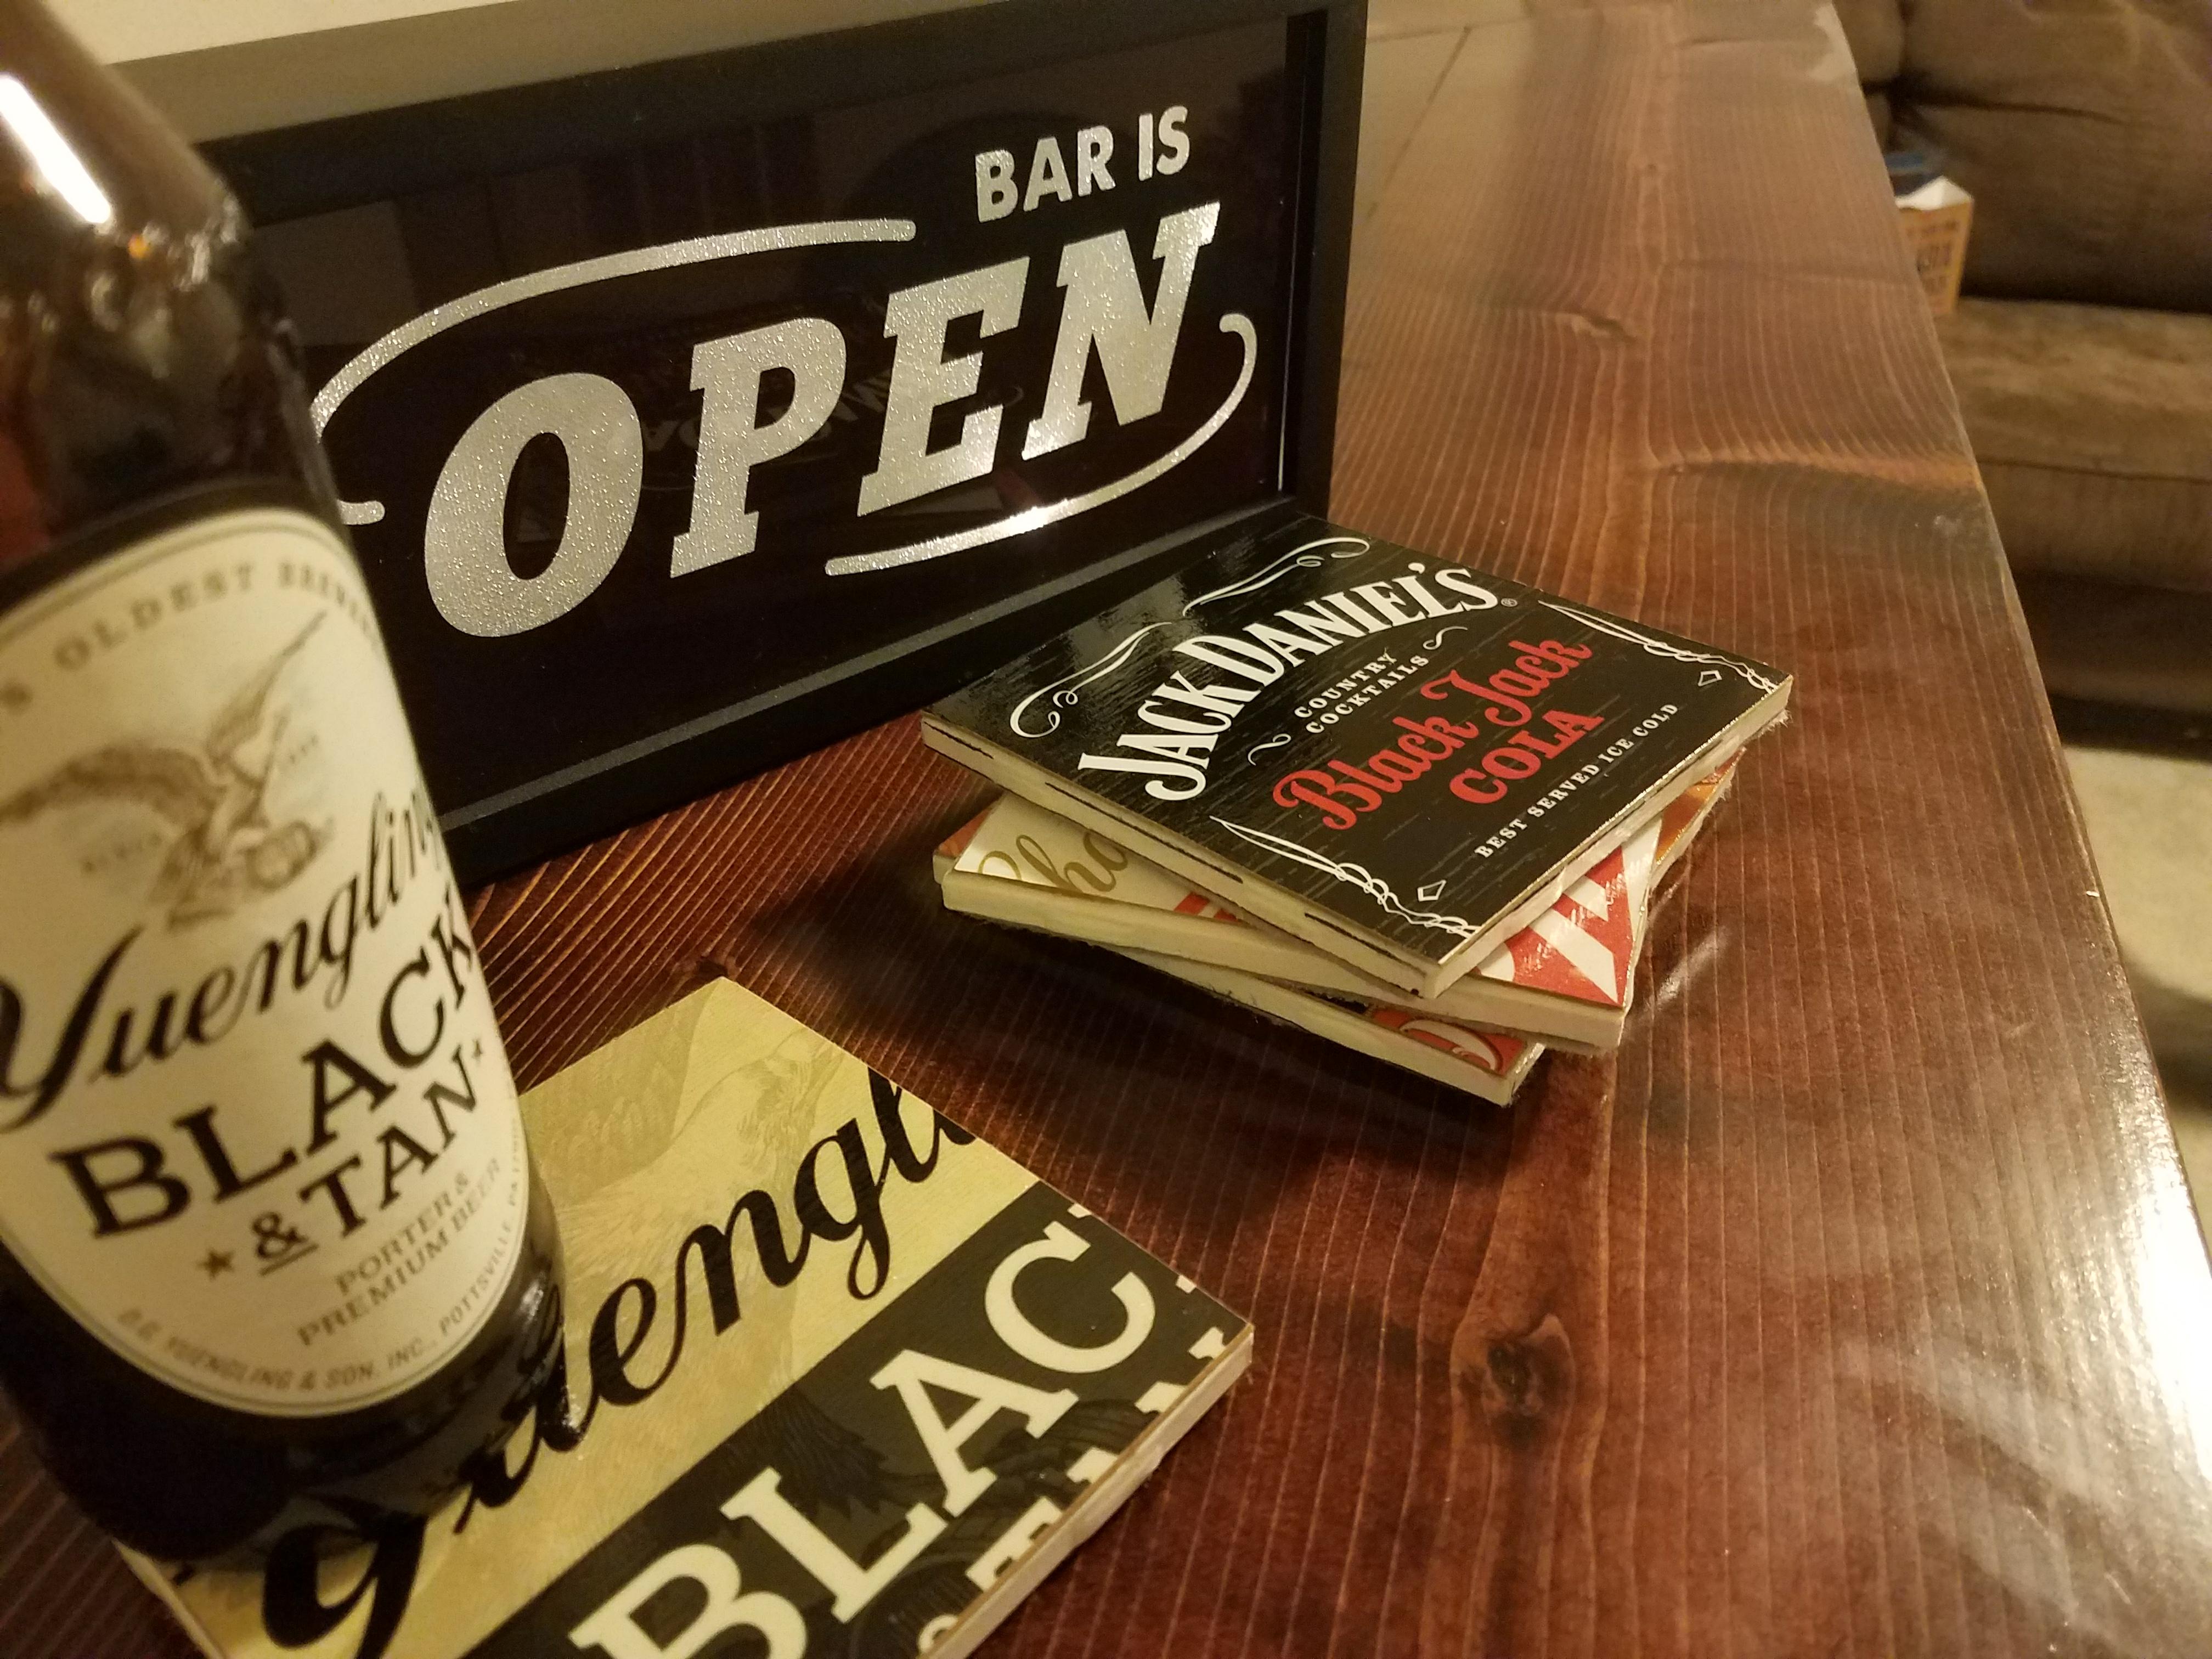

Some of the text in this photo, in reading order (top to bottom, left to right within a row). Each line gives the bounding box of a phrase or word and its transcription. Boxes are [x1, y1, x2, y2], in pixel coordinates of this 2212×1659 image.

[975, 105, 1190, 223] BAR IS
[424, 201, 1221, 638] OPEN
[54, 561, 253, 670] OLDEST
[1077, 562, 1499, 802] JACK DANIEL'S
[1294, 651, 1397, 719] COUNTRY
[1306, 654, 1429, 734] COCKTAILS
[1273, 638, 1593, 831] Black Jack
[1449, 709, 1605, 804] COLA
[1475, 702, 1679, 858] BEST SERVED ICE COLD
[49, 883, 473, 1239] BLACK
[251, 1210, 306, 1262] &
[300, 1043, 478, 1237] TAN
[297, 1156, 501, 1346] PREMIUM BEER
[336, 1192, 452, 1295] PORTER
[262, 1065, 978, 1659] uengl
[569, 1203, 1196, 1659] BLAC
